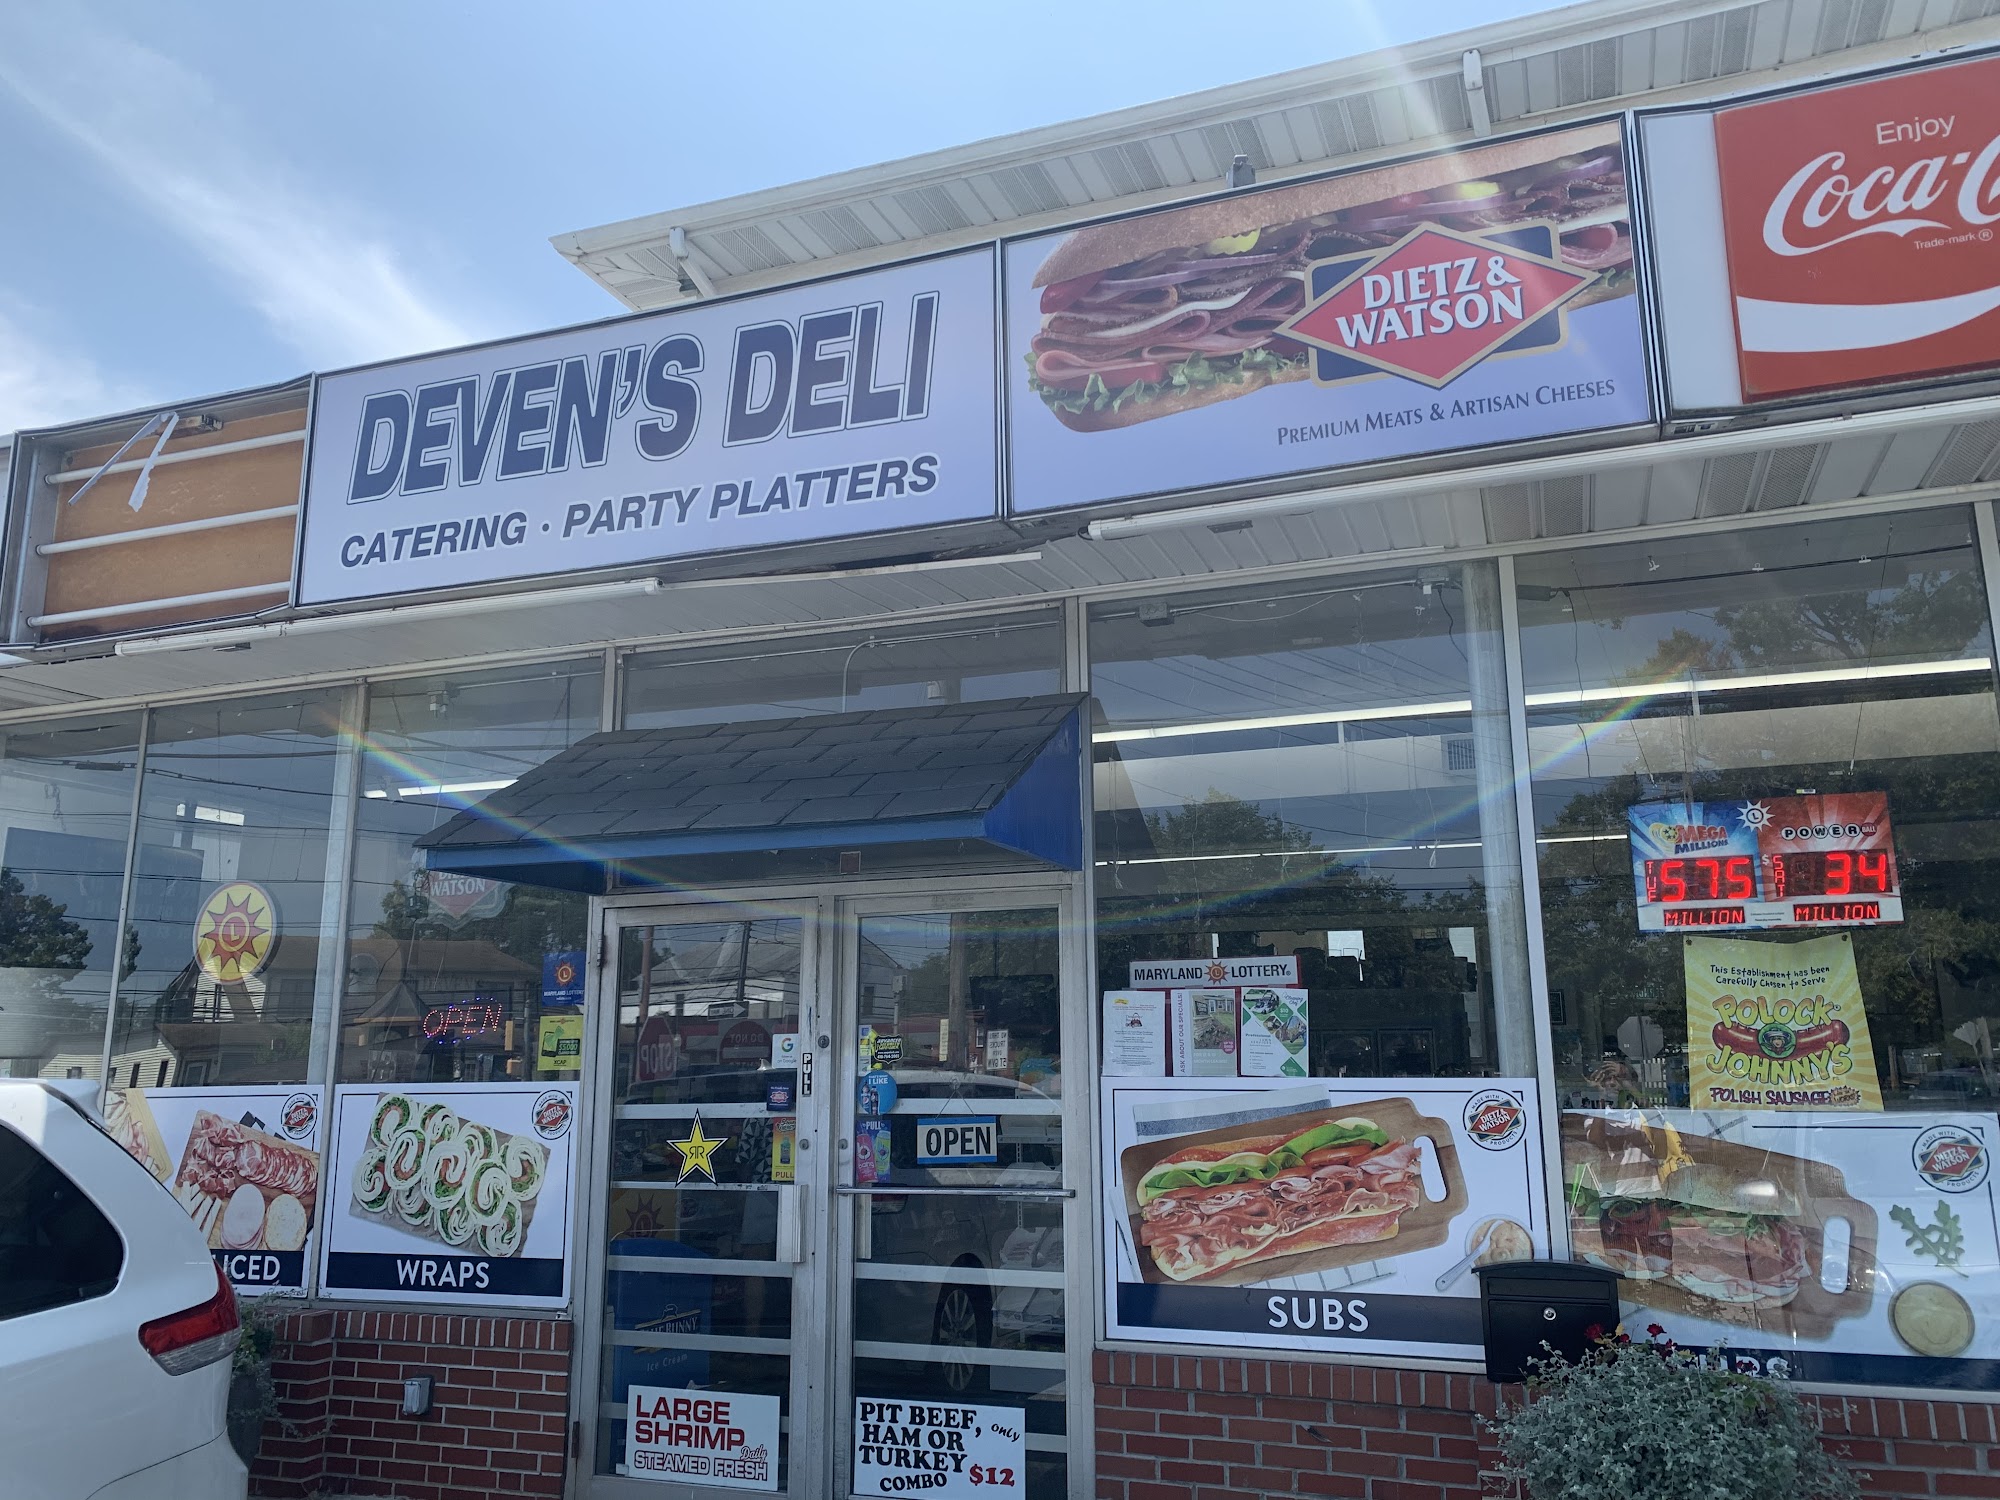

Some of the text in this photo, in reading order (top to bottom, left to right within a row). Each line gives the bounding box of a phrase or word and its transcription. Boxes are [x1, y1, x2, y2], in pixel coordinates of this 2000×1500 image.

[1875, 114, 1956, 145] Enjoy
[1762, 133, 2000, 257] Coca-C
[1913, 231, 1976, 250] Trade-mark
[1362, 253, 1522, 310] DIETZ &
[1335, 284, 1525, 349] WATSON
[346, 290, 940, 506] DEVEN'S DELI
[1429, 402, 1445, 421] &
[341, 454, 939, 569] CATERING PARTY PLATTERS
[1675, 825, 1727, 842] MEGA
[1674, 839, 1729, 854] MILLIONS
[1660, 857, 1752, 903] 575
[1825, 852, 1886, 896] 34
[430, 878, 486, 897] WATSON
[1665, 908, 1744, 926] MILLION
[1795, 903, 1879, 922] MILLION
[1134, 966, 1203, 981] MARYLAND
[1710, 964, 1830, 980] This Establishment has been
[1716, 976, 1757, 989] Carefully
[1759, 979, 1786, 989] Chosen
[1801, 976, 1826, 987] Serve
[423, 1003, 503, 1036] OPEN
[803, 1052, 812, 1095] PULL
[1706, 1041, 1853, 1086] JOHNNY'S
[873, 1077, 889, 1085] LIKE
[1709, 1087, 1762, 1105] POLISH
[1766, 1088, 1831, 1106] SAUSAGE
[865, 1120, 882, 1130] PULL
[1478, 1113, 1511, 1132] WATSON
[1480, 1109, 1501, 1124] DIETZ
[925, 1126, 991, 1156] OPEN
[1931, 1152, 1971, 1172] WATSON
[1932, 1147, 1958, 1163] DIETZ
[775, 1171, 794, 1179] PULL
[211, 1254, 281, 1281] ICED
[396, 1259, 490, 1289] WRAPS
[1266, 1295, 1369, 1333] SUBS
[636, 1394, 731, 1426] LARGE
[859, 1402, 982, 1438] PIT BEEF,
[635, 1420, 745, 1451] SHRIMP
[862, 1424, 965, 1452] HAM OR
[990, 1423, 1021, 1443] only
[634, 1450, 768, 1482] STEAMED FRESH
[740, 1444, 768, 1464] Daily
[858, 1445, 968, 1473] TURKEY
[879, 1472, 948, 1492] COMBO
[969, 1463, 1015, 1487] $12
